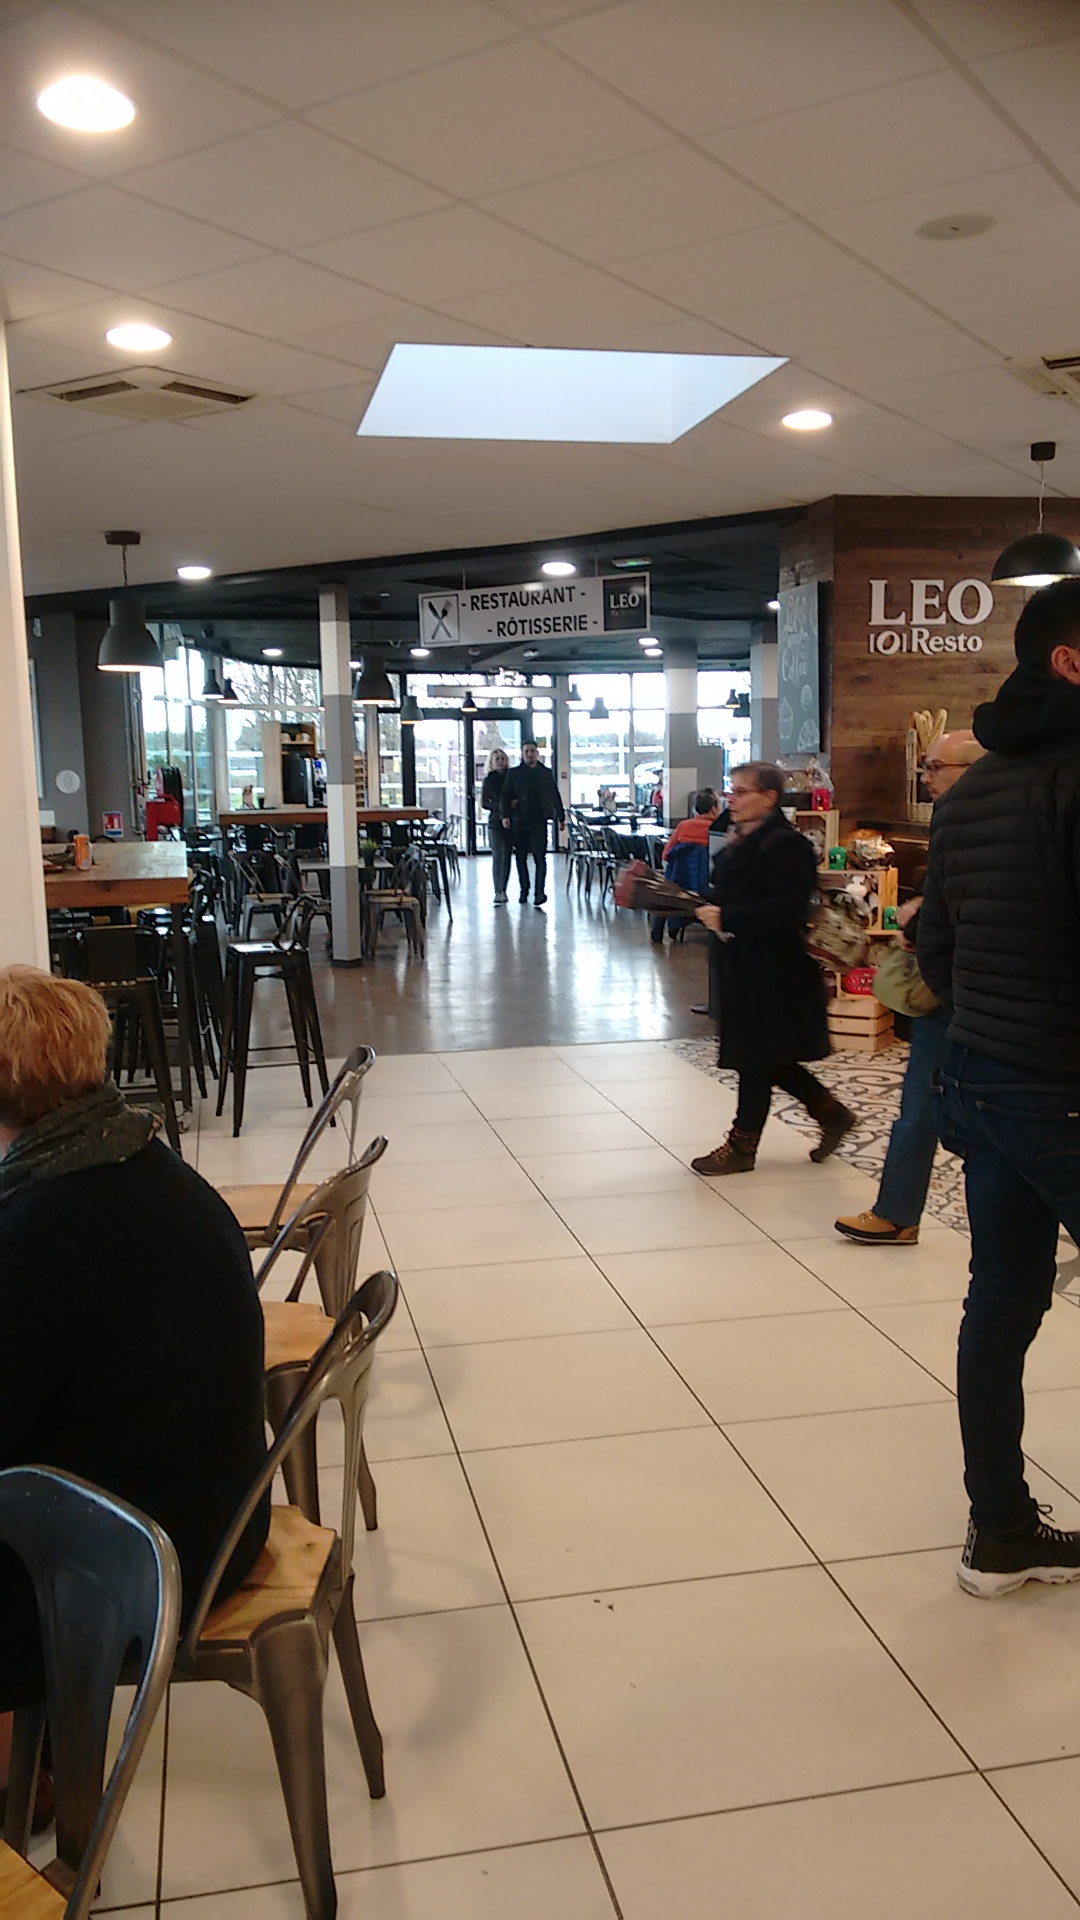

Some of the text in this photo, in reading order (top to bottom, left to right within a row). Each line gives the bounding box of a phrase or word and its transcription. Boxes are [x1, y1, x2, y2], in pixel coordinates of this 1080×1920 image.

[470, 585, 576, 612] RESTAURANT
[609, 593, 640, 608] LEO
[868, 578, 993, 626] LEO
[911, 627, 983, 655] Resto
